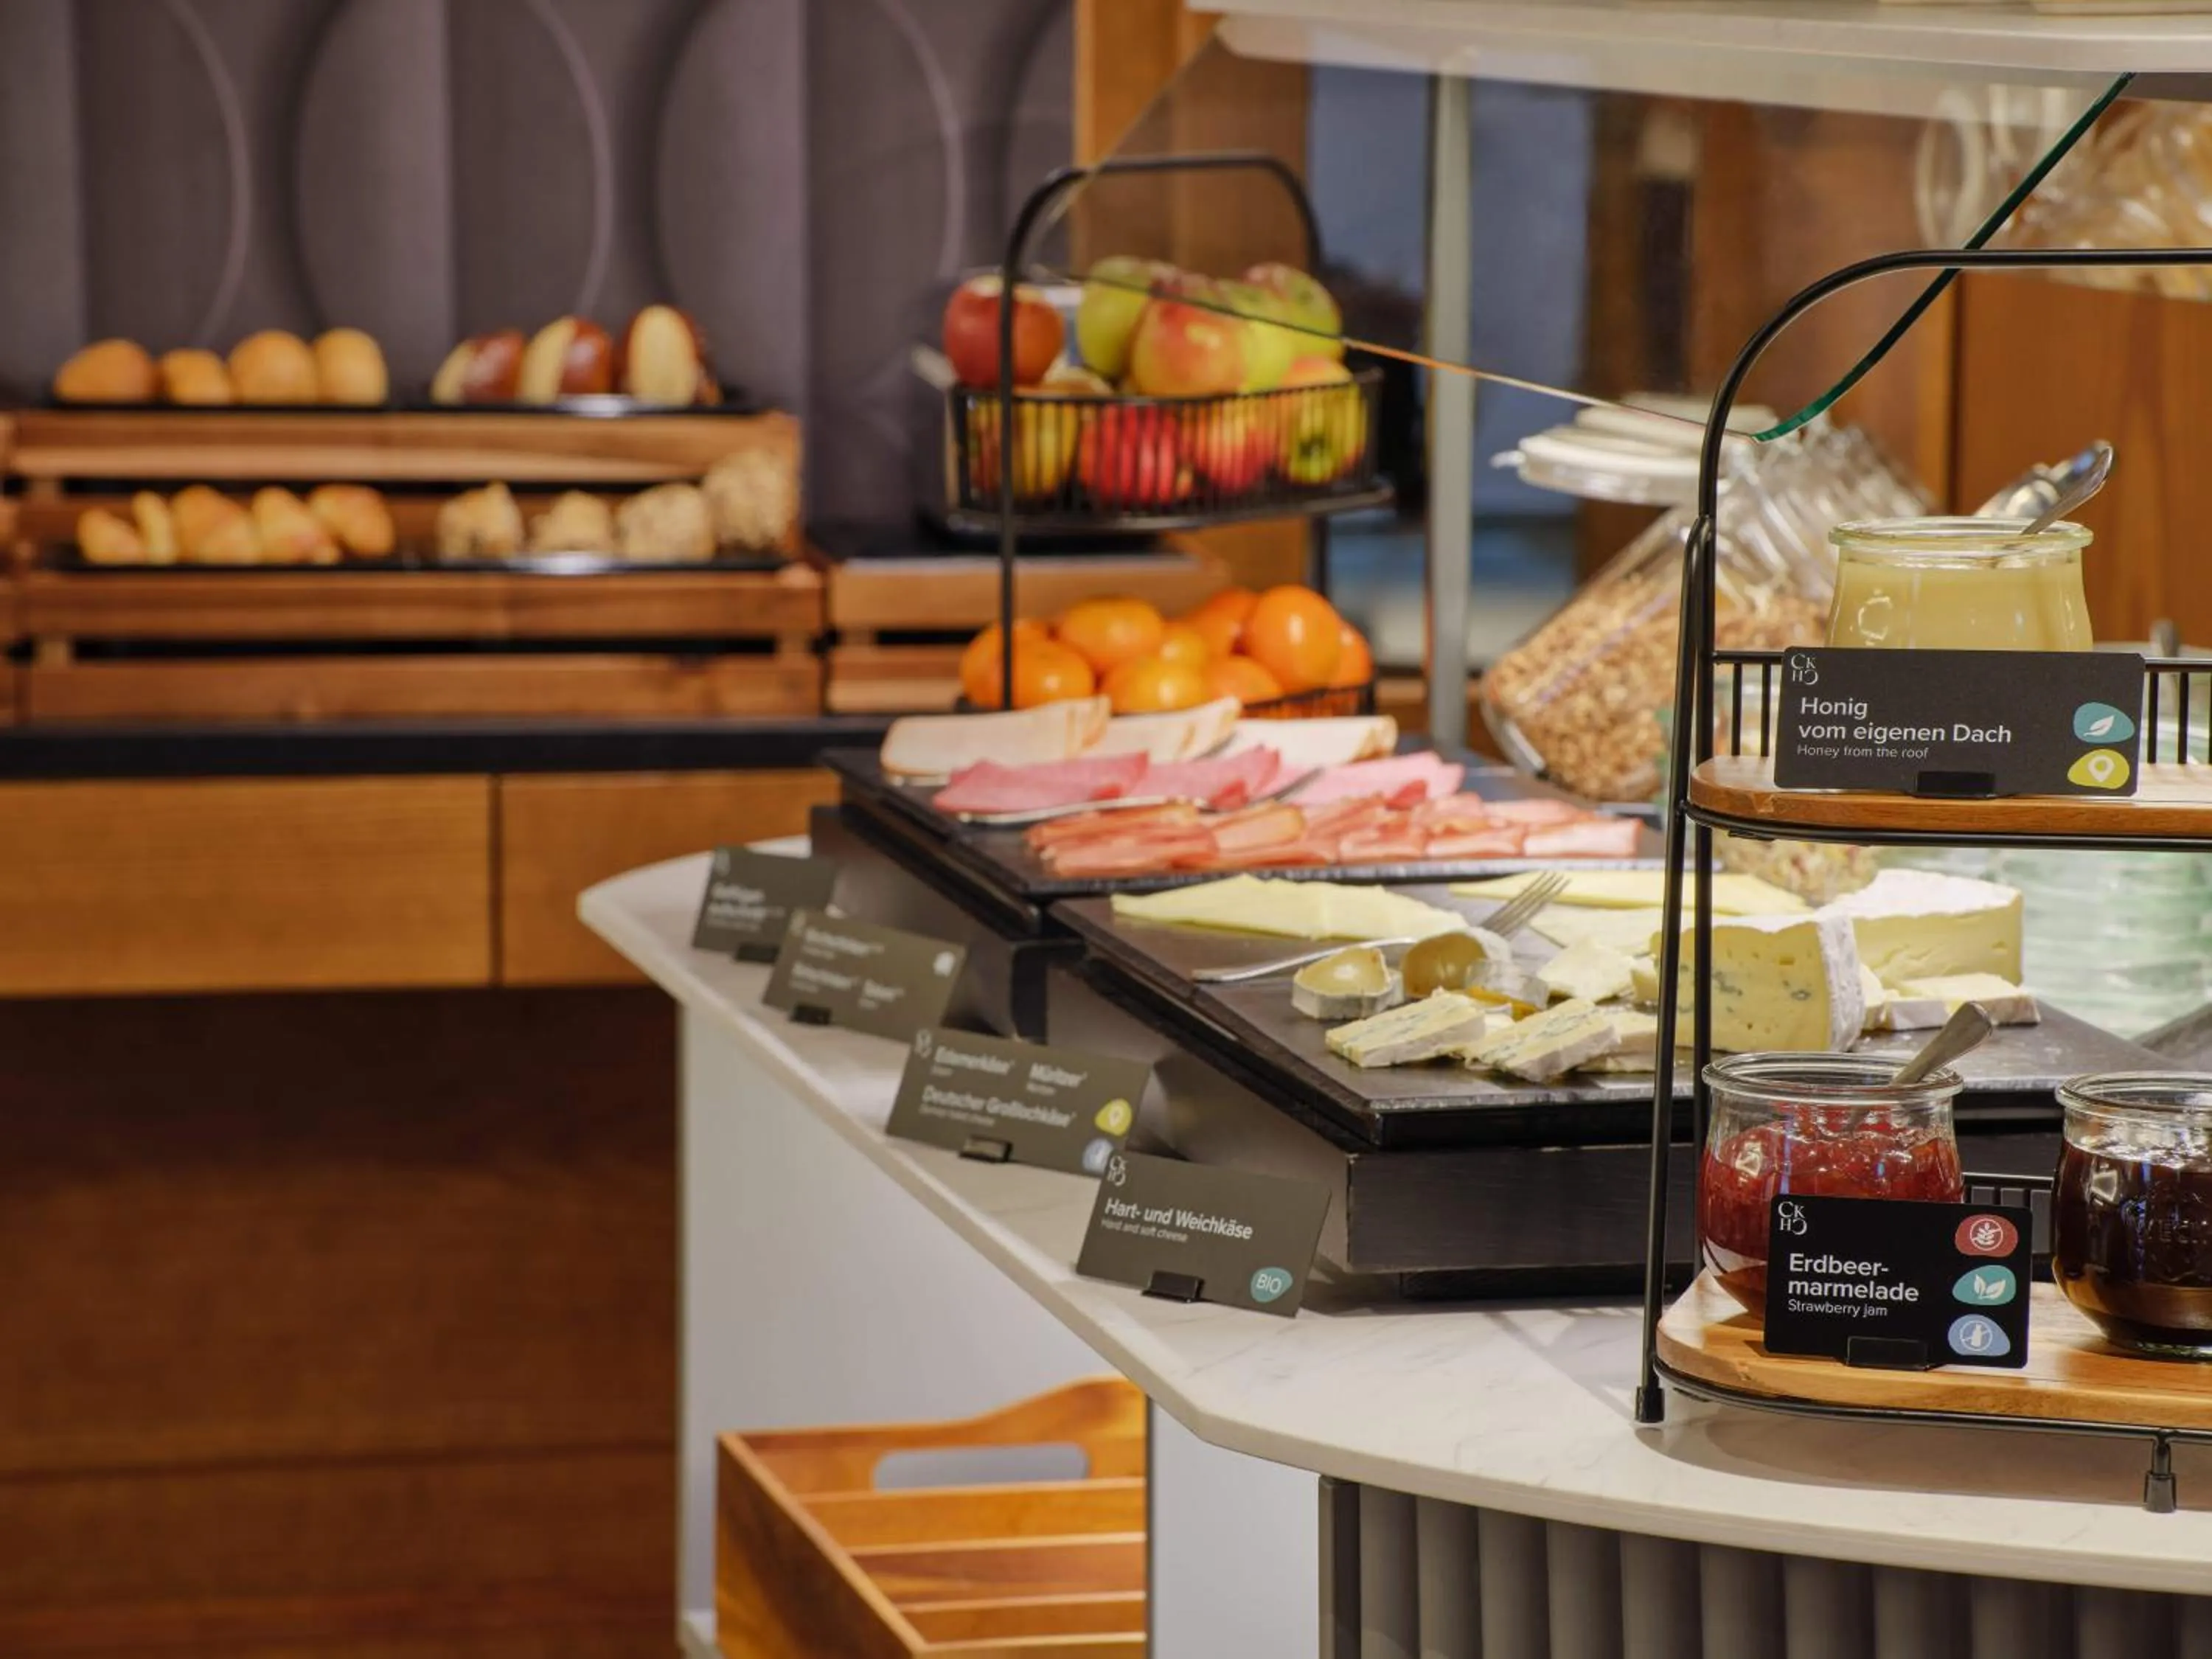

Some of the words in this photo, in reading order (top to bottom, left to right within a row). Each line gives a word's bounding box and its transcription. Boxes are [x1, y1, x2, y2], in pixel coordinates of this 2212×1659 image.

[1800, 696, 1868, 720] Honig
[1798, 724, 1846, 740] vom
[1853, 723, 1946, 744] eigenen
[1952, 723, 2011, 743] Dach
[1797, 744, 1840, 759] Honey
[1843, 745, 1873, 757] from
[1876, 745, 1897, 758] the
[1902, 746, 1930, 759] roof
[1105, 1197, 1141, 1219] Hart-
[1144, 1207, 1172, 1225] und
[1175, 1209, 1253, 1240] Weichkäse
[1789, 1252, 1889, 1277] Erdbeer-
[1255, 1273, 1283, 1293] BIO
[1788, 1279, 1919, 1302] marmelade
[1788, 1299, 1860, 1318] Strawberry
[1863, 1302, 1888, 1318] jam
